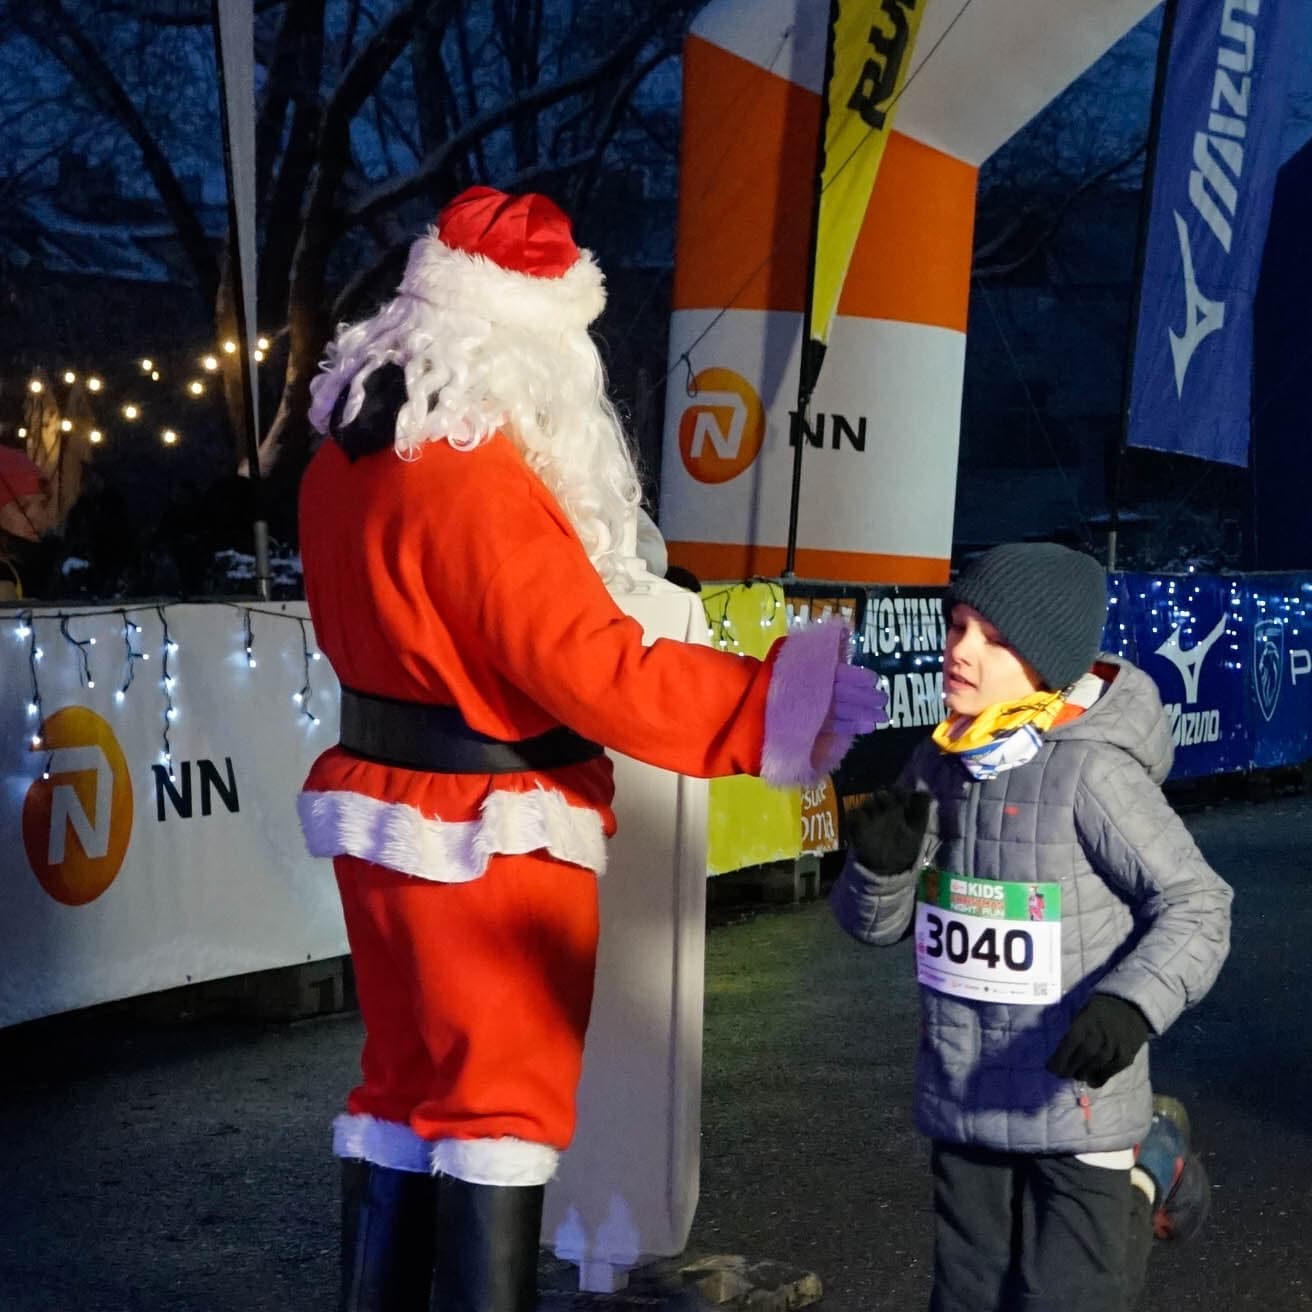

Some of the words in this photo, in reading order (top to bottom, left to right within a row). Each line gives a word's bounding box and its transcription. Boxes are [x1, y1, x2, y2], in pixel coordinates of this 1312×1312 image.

[788, 410, 867, 452] NN
[151, 757, 241, 822] NN
[967, 882, 1005, 900] KIDS
[926, 912, 1034, 972] 3040
